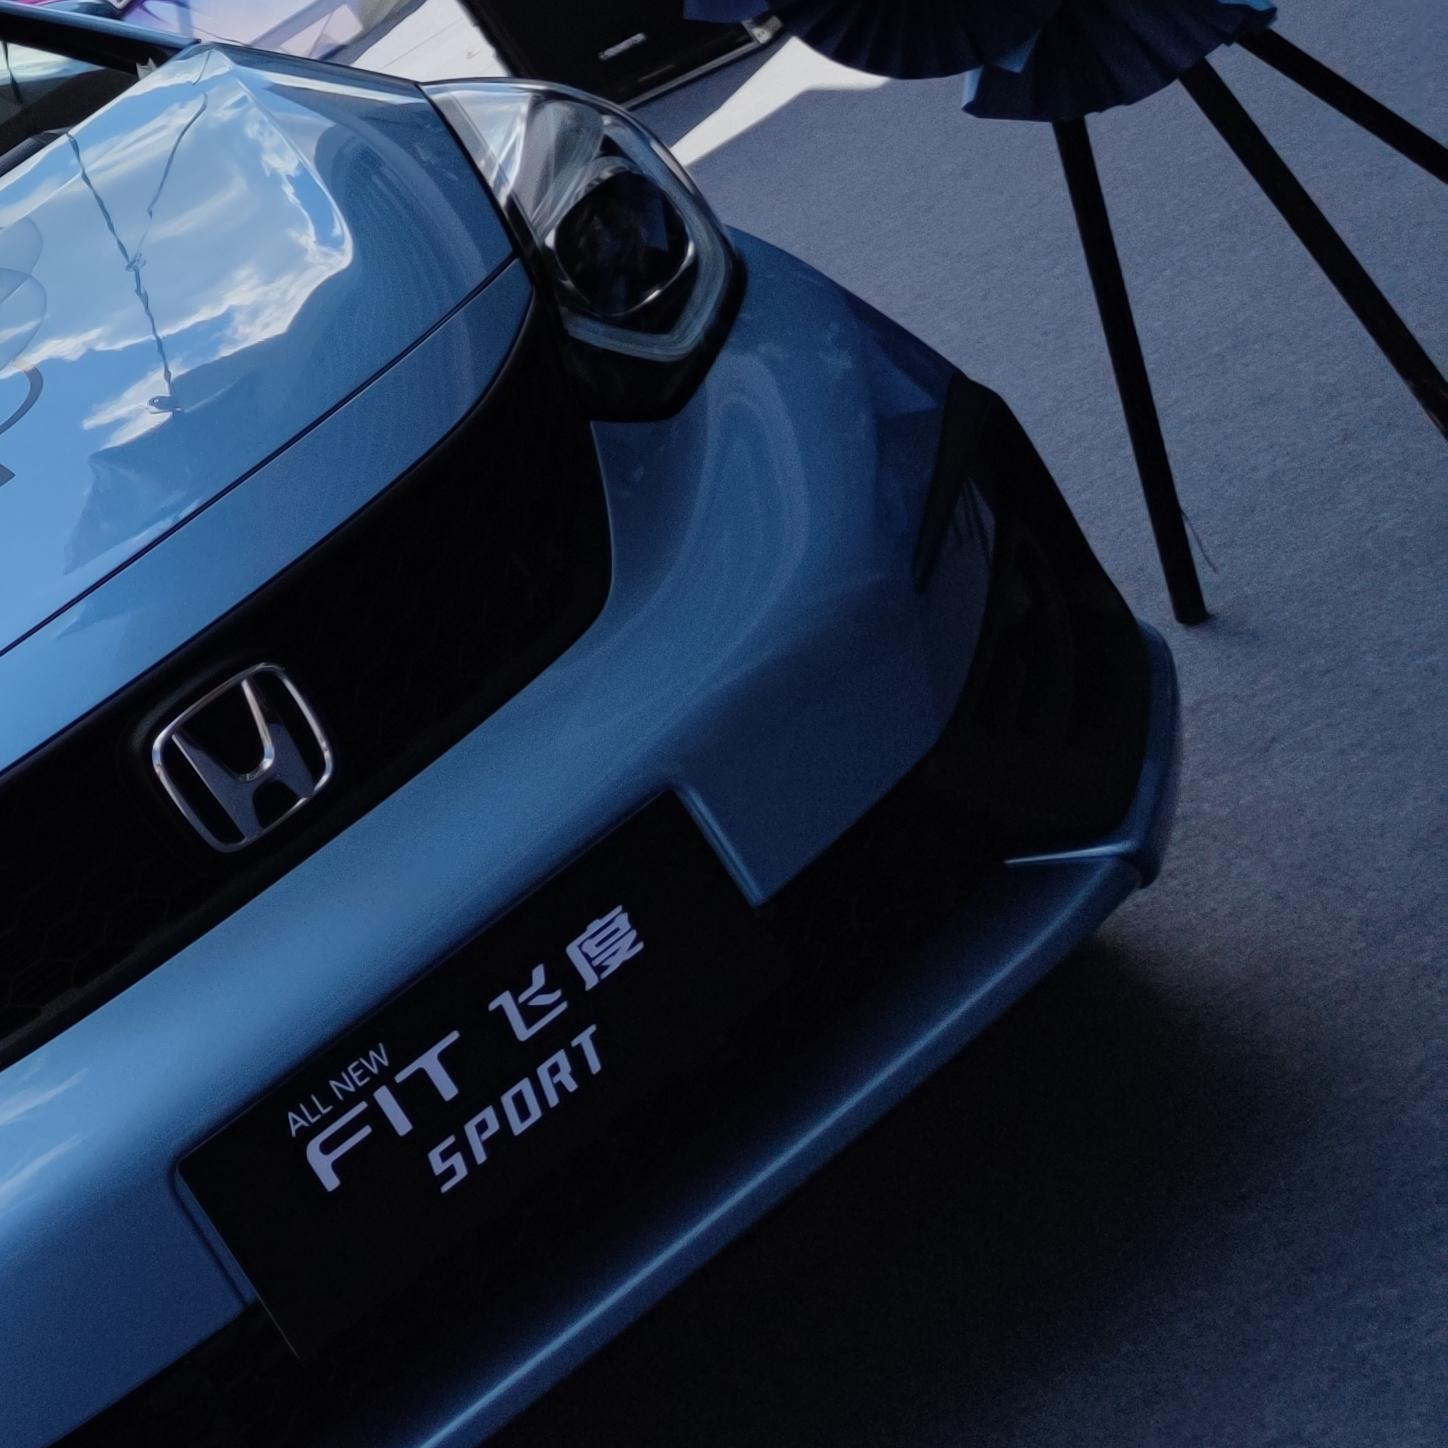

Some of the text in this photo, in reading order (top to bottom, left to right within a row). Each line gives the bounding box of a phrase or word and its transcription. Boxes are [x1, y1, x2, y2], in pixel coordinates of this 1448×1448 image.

[287, 1042, 390, 1138] ALL NEW
[306, 904, 645, 1192] FIT 飞度
[426, 1024, 603, 1195] SPORT
